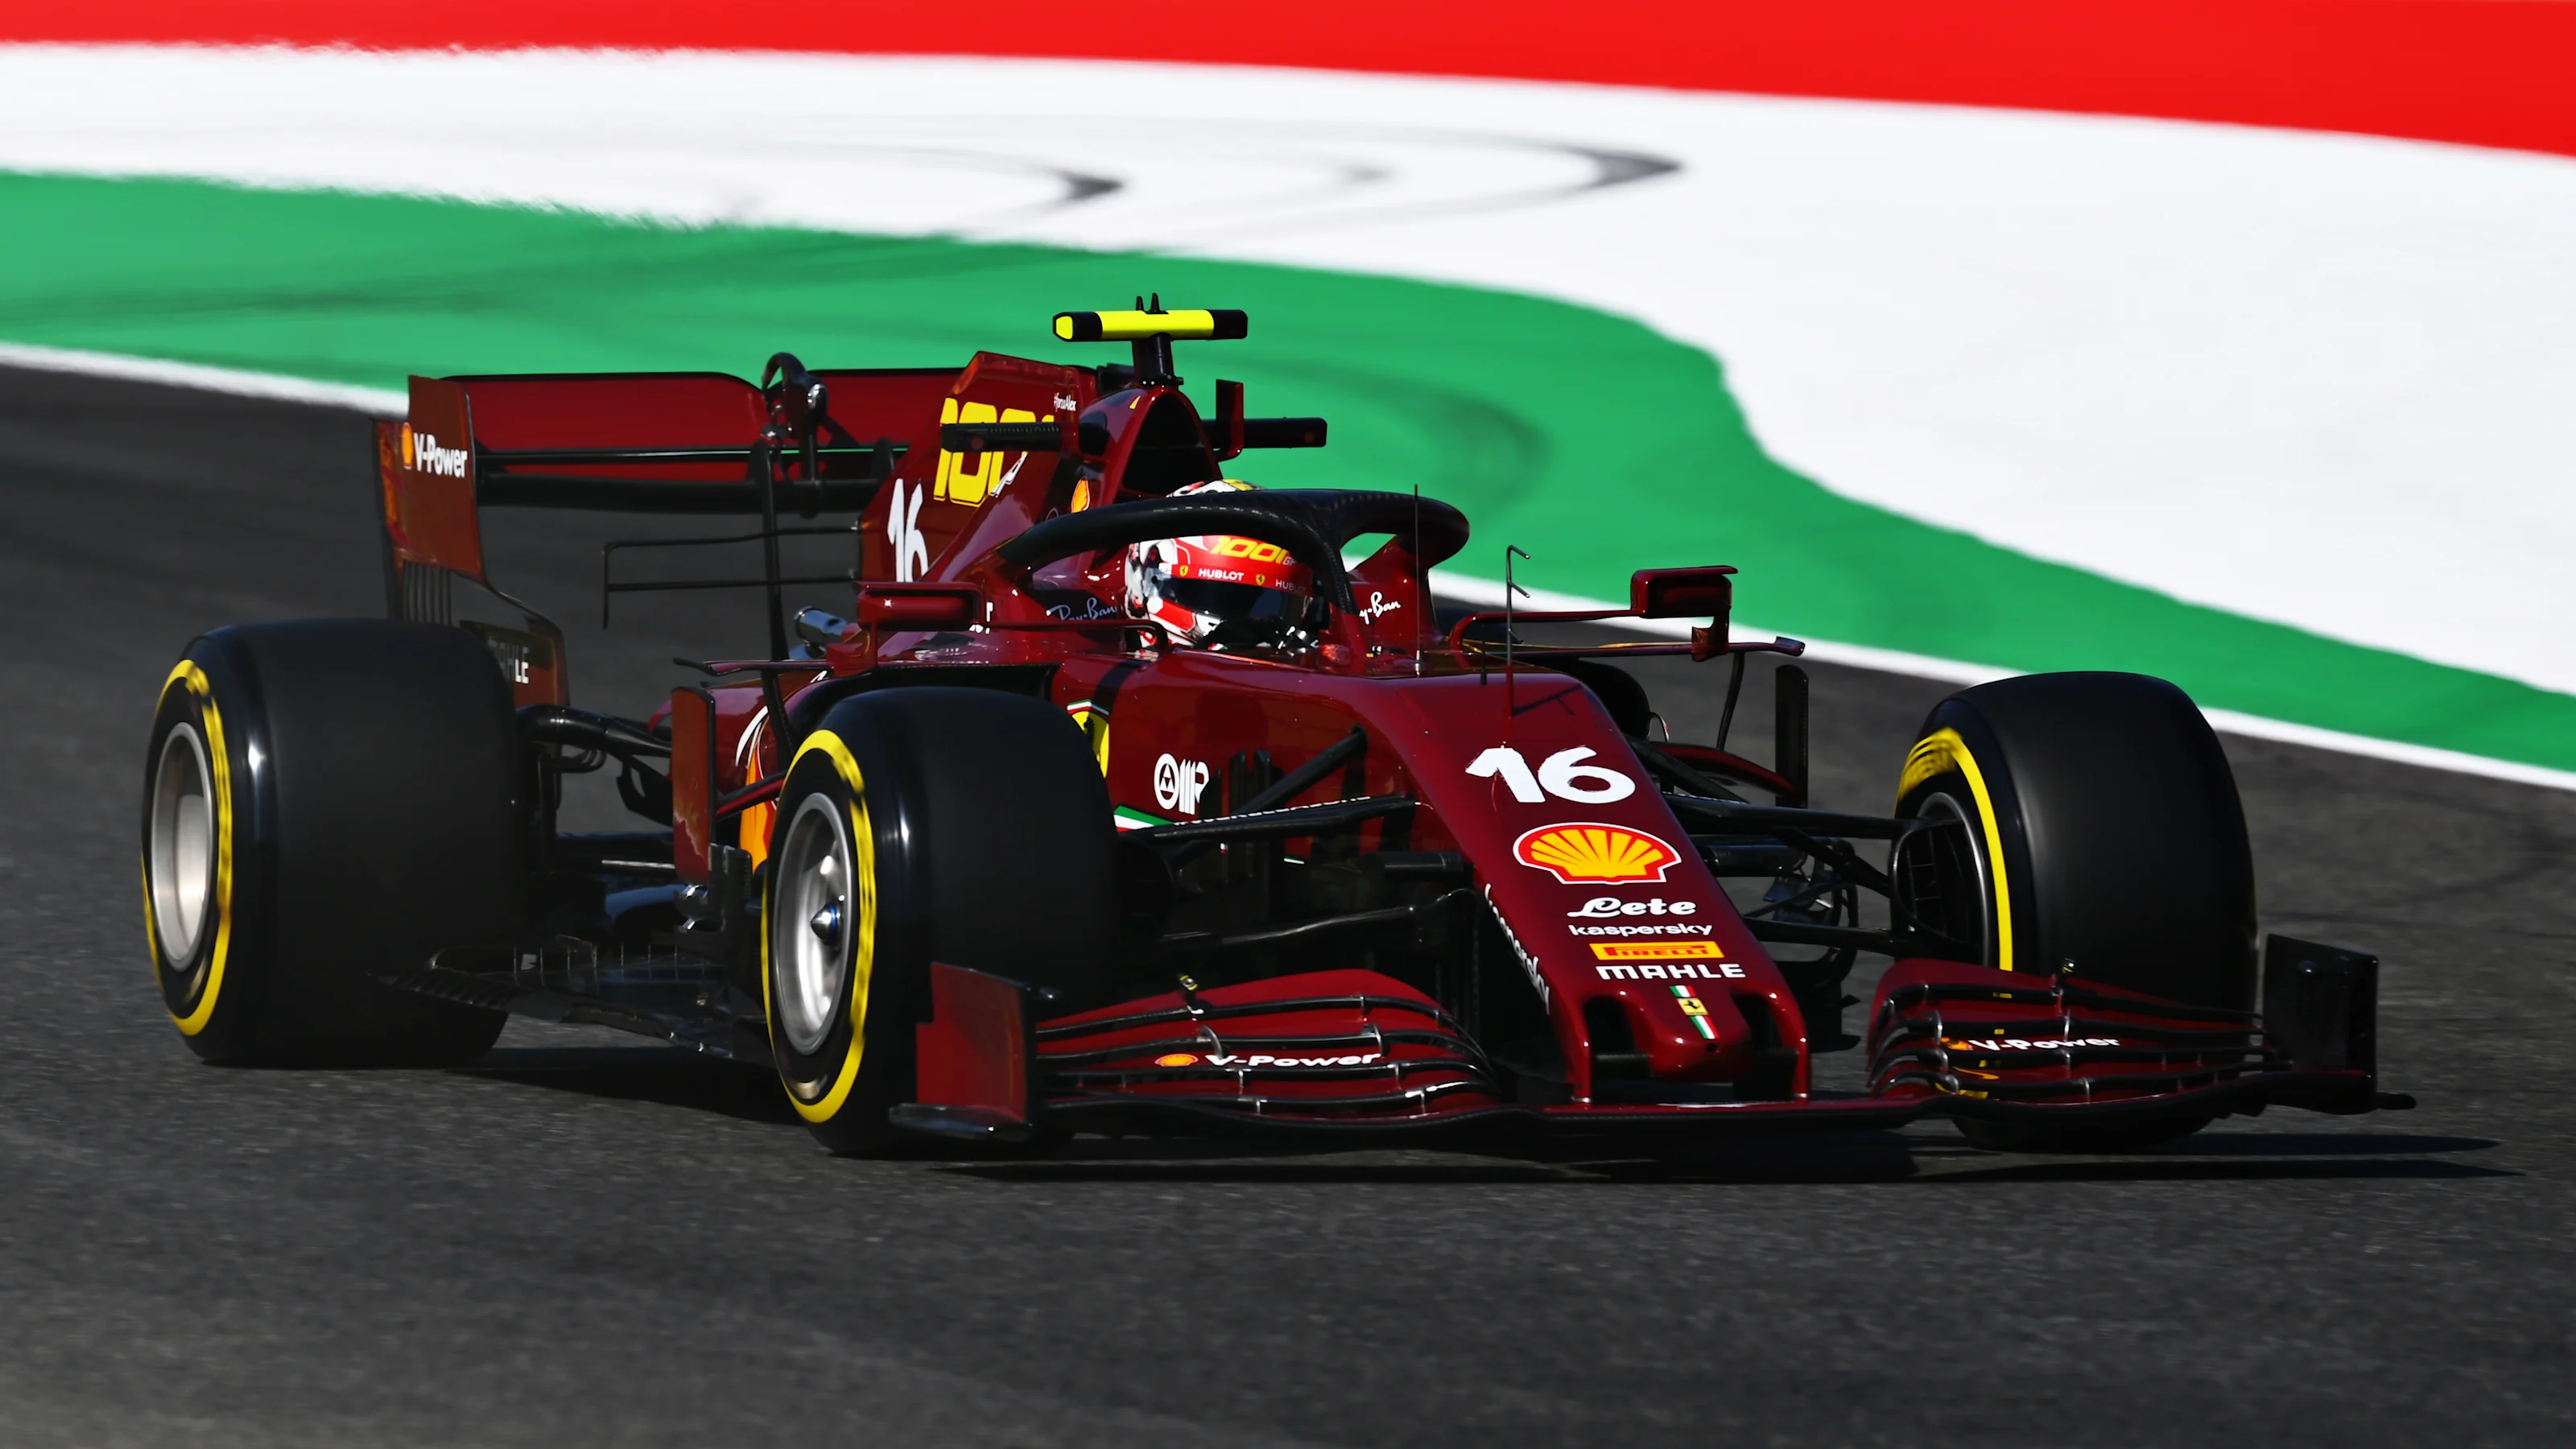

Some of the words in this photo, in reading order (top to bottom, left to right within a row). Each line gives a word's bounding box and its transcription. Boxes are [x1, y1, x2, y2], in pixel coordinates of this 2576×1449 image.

[413, 432, 468, 478] V-Power
[888, 478, 929, 583] 16
[1198, 568, 1245, 581] HUBLOT
[1275, 579, 1307, 594] HUBLOT
[1465, 745, 1636, 803] 16
[1567, 897, 1697, 918] Lete
[1568, 923, 1712, 937] kaspersky
[1603, 945, 1710, 956] PIRELLI
[1596, 964, 1746, 980] MAHLE
[1969, 1038, 2120, 1051] V-Power
[1205, 1053, 1381, 1067] V-Power
